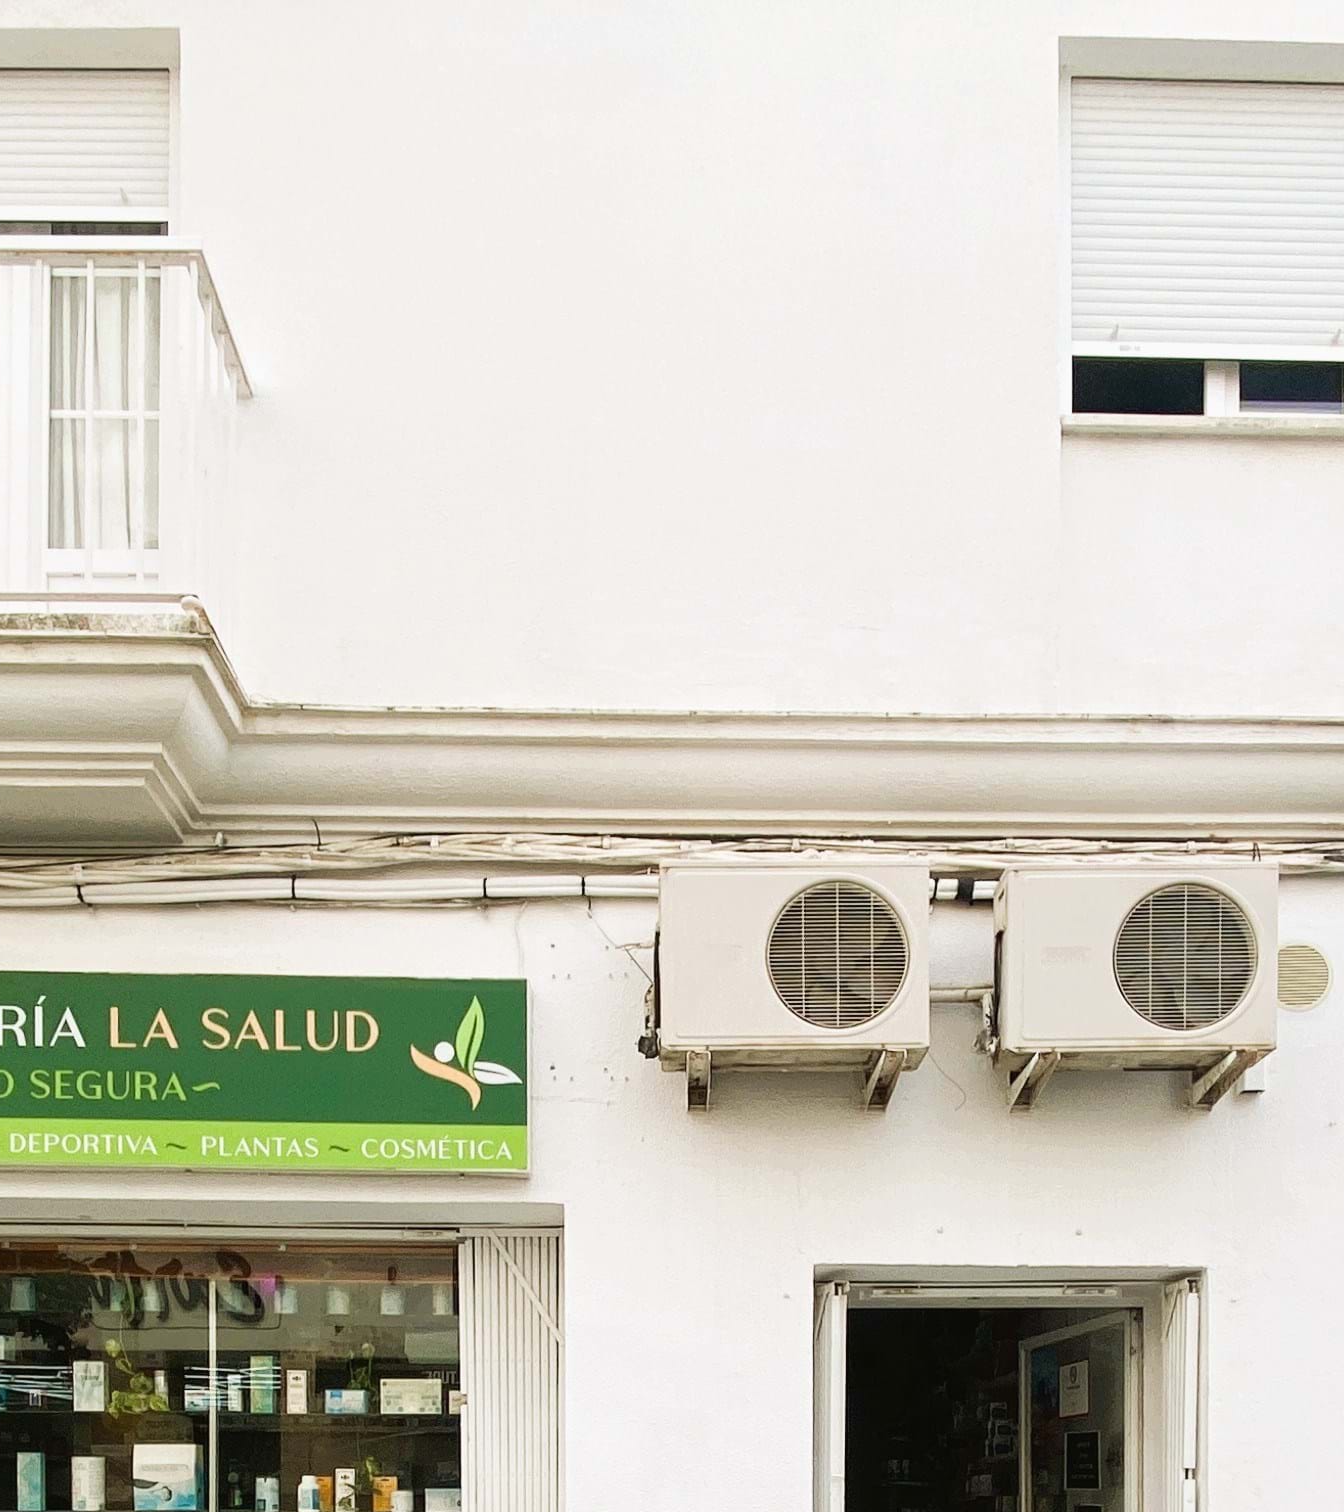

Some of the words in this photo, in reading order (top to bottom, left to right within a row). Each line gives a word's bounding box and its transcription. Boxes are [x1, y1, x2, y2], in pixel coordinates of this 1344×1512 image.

[109, 1006, 179, 1049] LA
[201, 1007, 380, 1052] SALUD
[9, 1133, 158, 1156] DEPORTIVA
[201, 1135, 319, 1158] PLANTAS
[361, 1132, 513, 1161] COSMÉTICA
